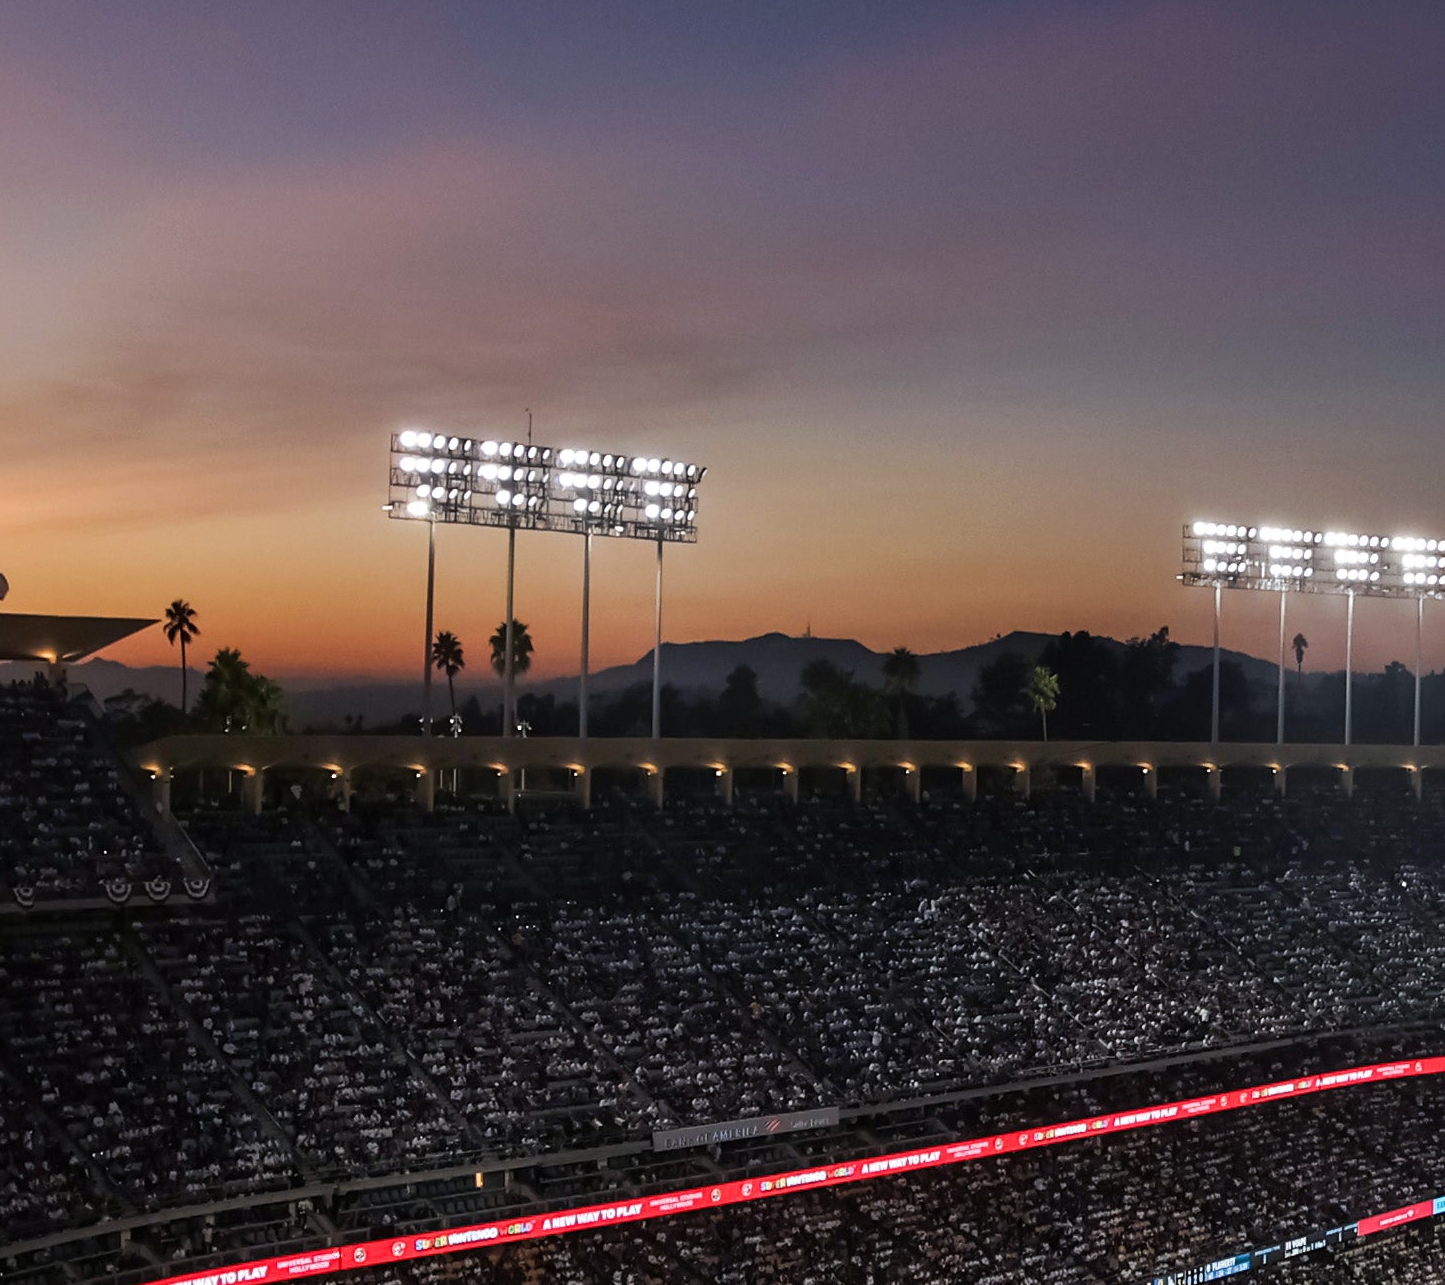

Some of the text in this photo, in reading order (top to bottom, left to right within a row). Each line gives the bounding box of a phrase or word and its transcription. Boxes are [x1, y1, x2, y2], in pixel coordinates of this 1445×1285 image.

[869, 1161, 888, 1173] NEW
[889, 1158, 907, 1170] WAY
[908, 1155, 919, 1166] TO
[920, 1151, 941, 1164] PLAY
[542, 1204, 642, 1231] A NEW WAY TO PLAY
[416, 1222, 533, 1251] SUPER NINTENDO WORLD
[237, 1266, 268, 1283] PLAY
